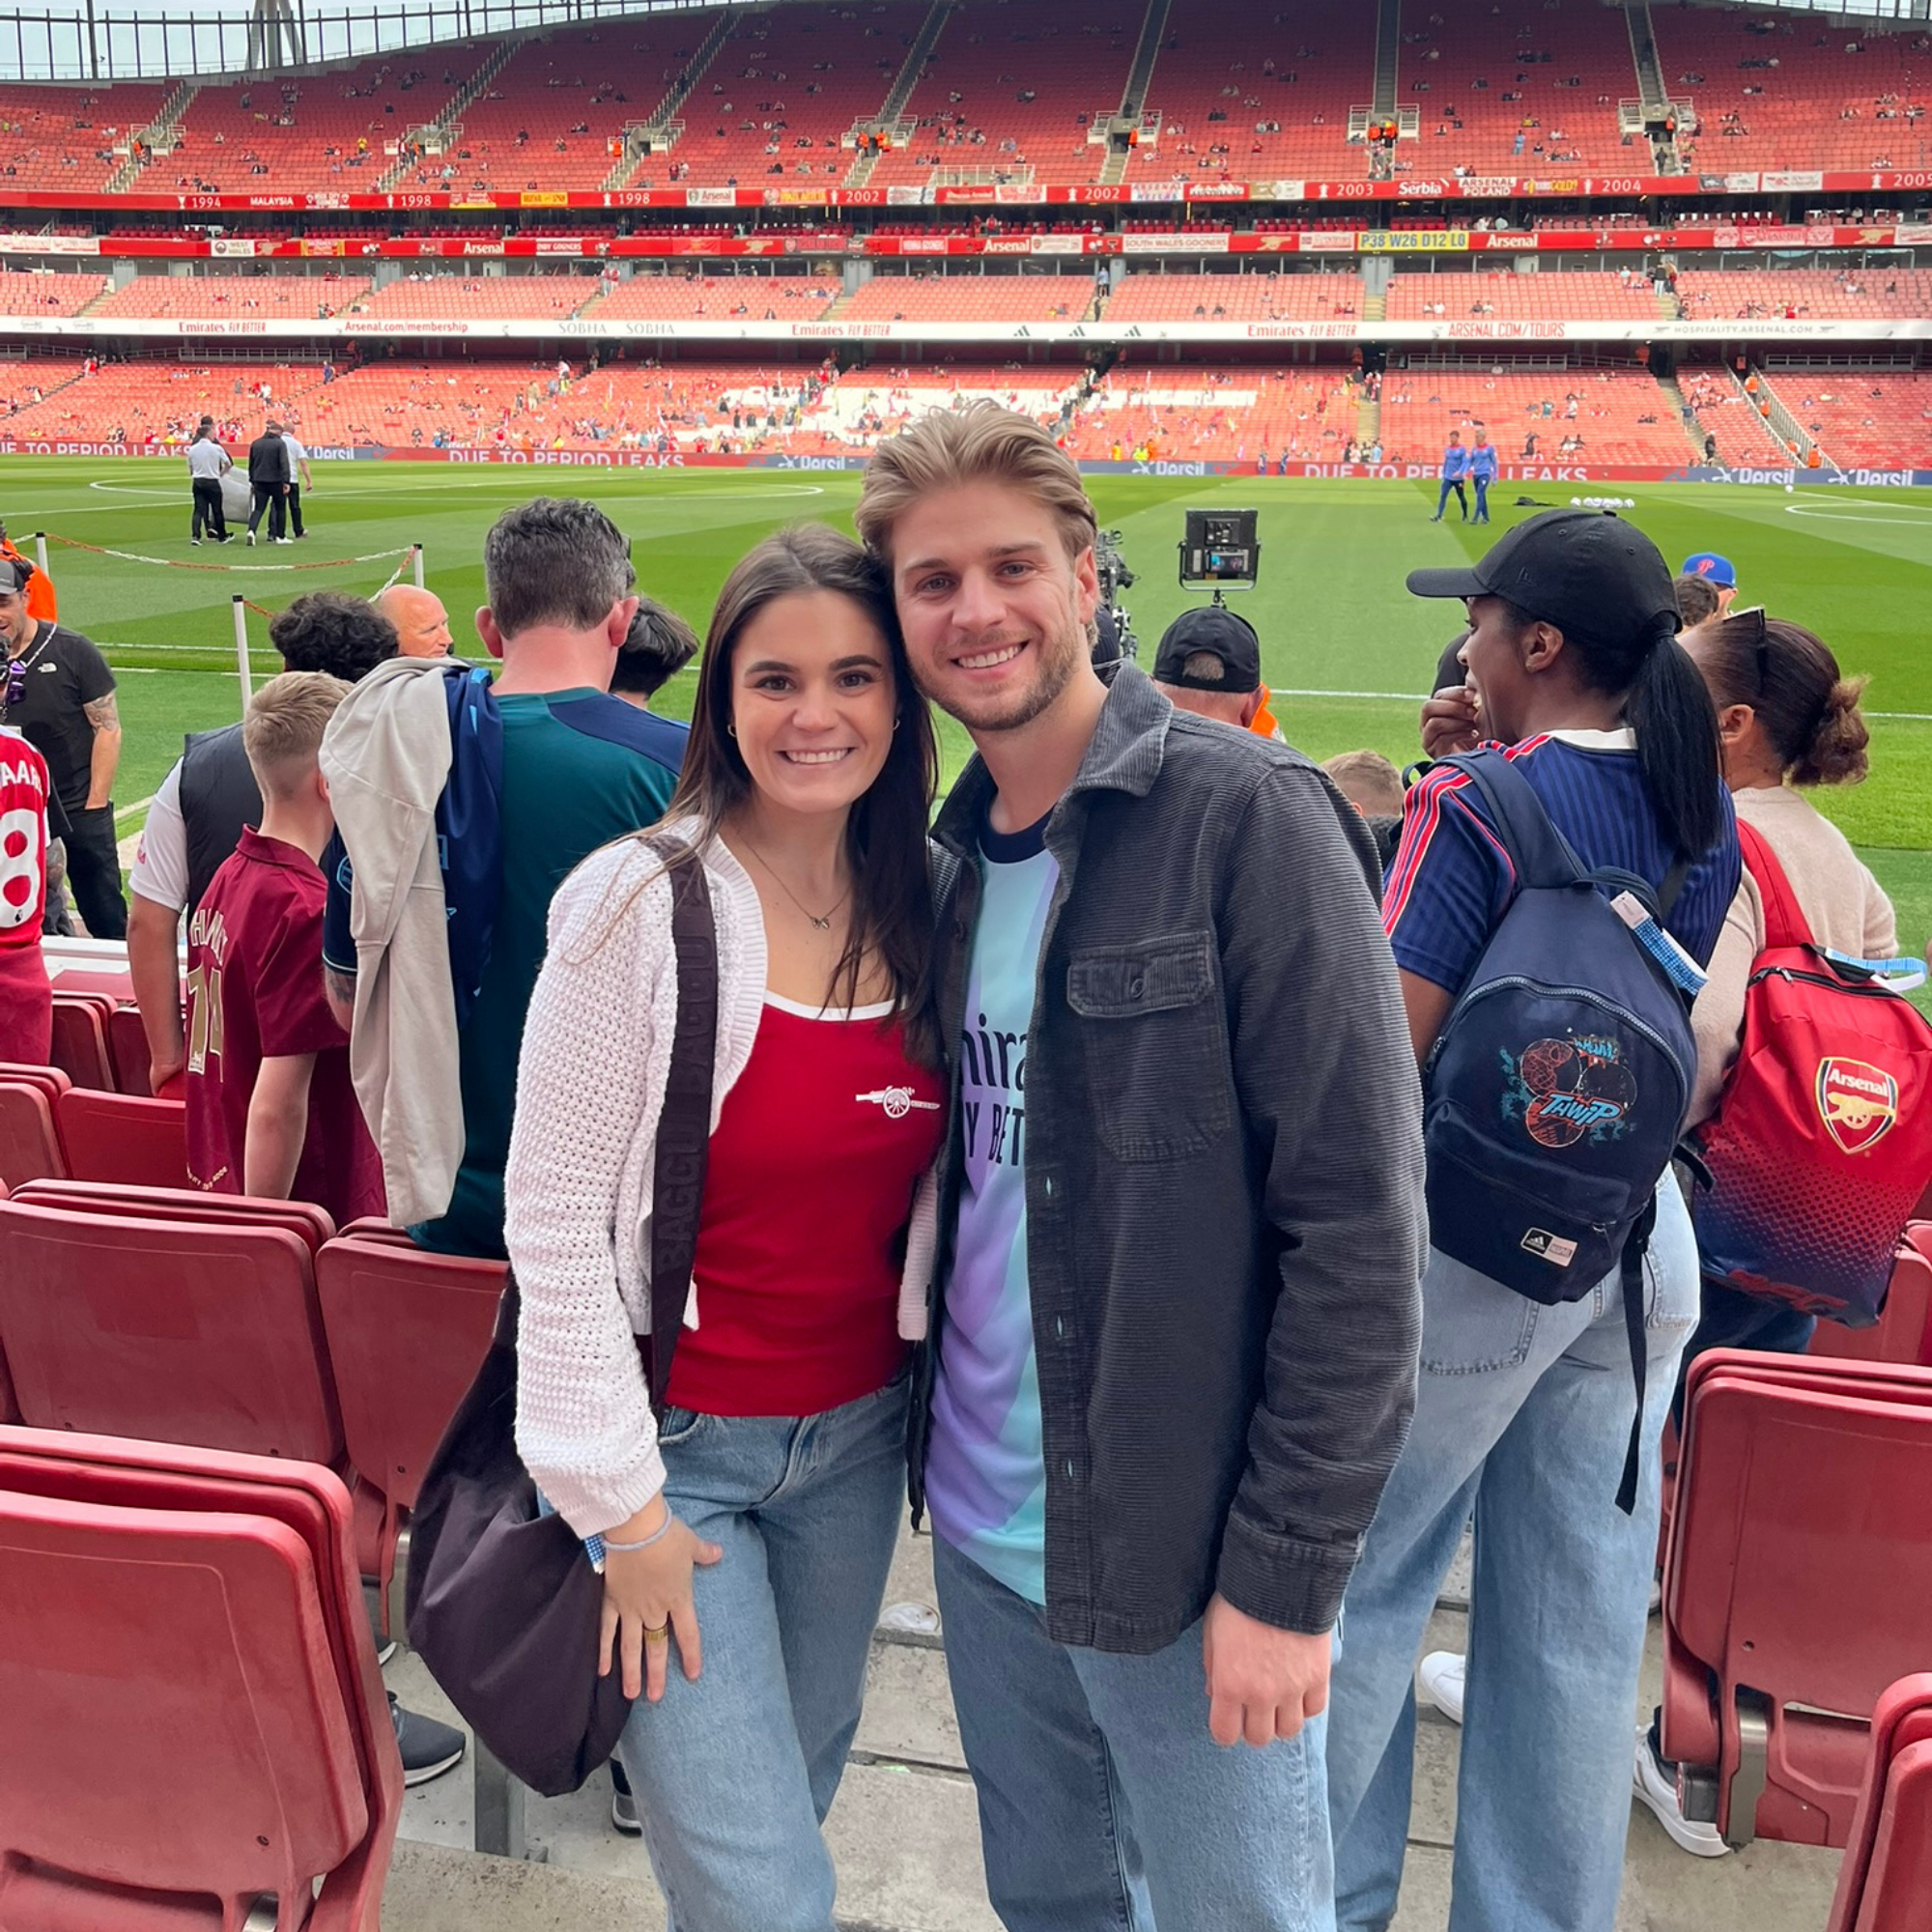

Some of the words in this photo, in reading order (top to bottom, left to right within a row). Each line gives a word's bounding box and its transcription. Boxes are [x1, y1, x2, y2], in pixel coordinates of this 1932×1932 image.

[1337, 184, 1374, 195] 2003
[1399, 182, 1442, 194] Serbia
[1463, 186, 1511, 196] POLAND
[1602, 180, 1641, 191] 2004
[618, 193, 650, 204] 1998
[846, 191, 879, 202] 2002
[1085, 187, 1120, 199] 2002
[192, 197, 221, 208] 1994
[250, 196, 294, 206] MALAYSIA
[401, 195, 432, 207] 1998
[983, 240, 1029, 252] Arsenal
[1124, 239, 1152, 247] SOUTH
[1155, 239, 1183, 247] WALES
[1186, 239, 1227, 247] GOONERS
[1361, 234, 1385, 247] P38
[1389, 234, 1416, 247] W26
[1421, 234, 1447, 247] D12
[1487, 234, 1538, 247] Arsenal
[464, 242, 504, 254] Arsenal
[179, 322, 225, 332] Emirates
[229, 322, 240, 332] FLY
[242, 322, 266, 332] BETTER
[345, 322, 469, 333] Arsenal.com/membership
[558, 323, 608, 334] SOBHA
[626, 323, 675, 334] SOBHA
[792, 324, 843, 336] Emirates
[848, 324, 860, 336] FLY
[863, 324, 891, 336] BETTER
[1247, 324, 1304, 337] Emirates
[1309, 324, 1322, 336] FLY
[1326, 324, 1357, 336] BETTER
[1449, 323, 1565, 337] ARSENAL.COM/TOURS
[25, 441, 51, 455] TO
[57, 442, 127, 455] PERIOD
[449, 450, 490, 464] DUE
[499, 450, 526, 464] TO
[535, 452, 611, 466] PERIOD
[618, 454, 685, 467] LEAKS
[1304, 464, 1354, 478] DUE
[1365, 464, 1398, 478] TO
[1507, 467, 1587, 481] LEAKS
[1828, 1067, 1889, 1097] Arsenal
